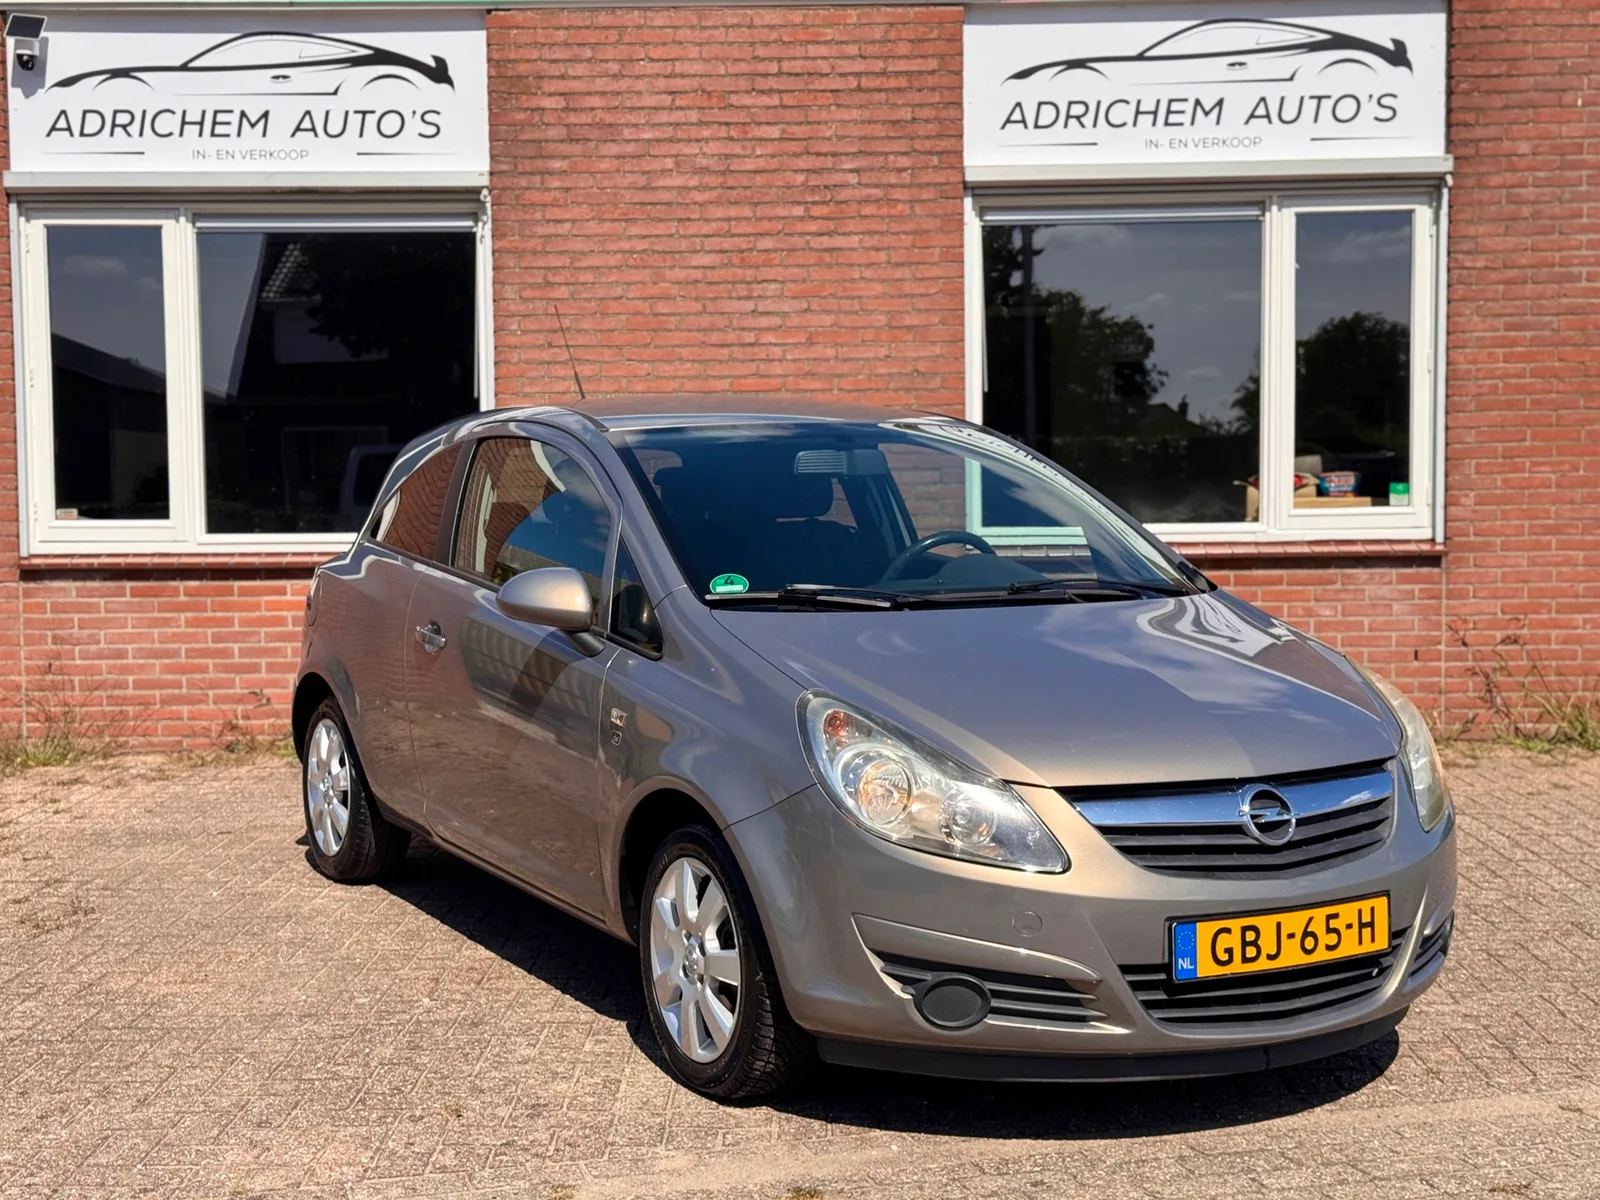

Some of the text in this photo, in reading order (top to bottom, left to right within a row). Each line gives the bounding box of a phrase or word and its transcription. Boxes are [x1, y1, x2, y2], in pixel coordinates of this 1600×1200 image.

[1000, 92, 1398, 131] ADRICHEM AUTO'S
[45, 109, 442, 139] ADRICHEM AUTO'S
[1145, 136, 1262, 149] IN- EN VERKOOP
[192, 149, 309, 160] IN- EN VERKOOP
[723, 575, 735, 585] 4
[1177, 905, 1376, 970] NL GBJ-65-H
